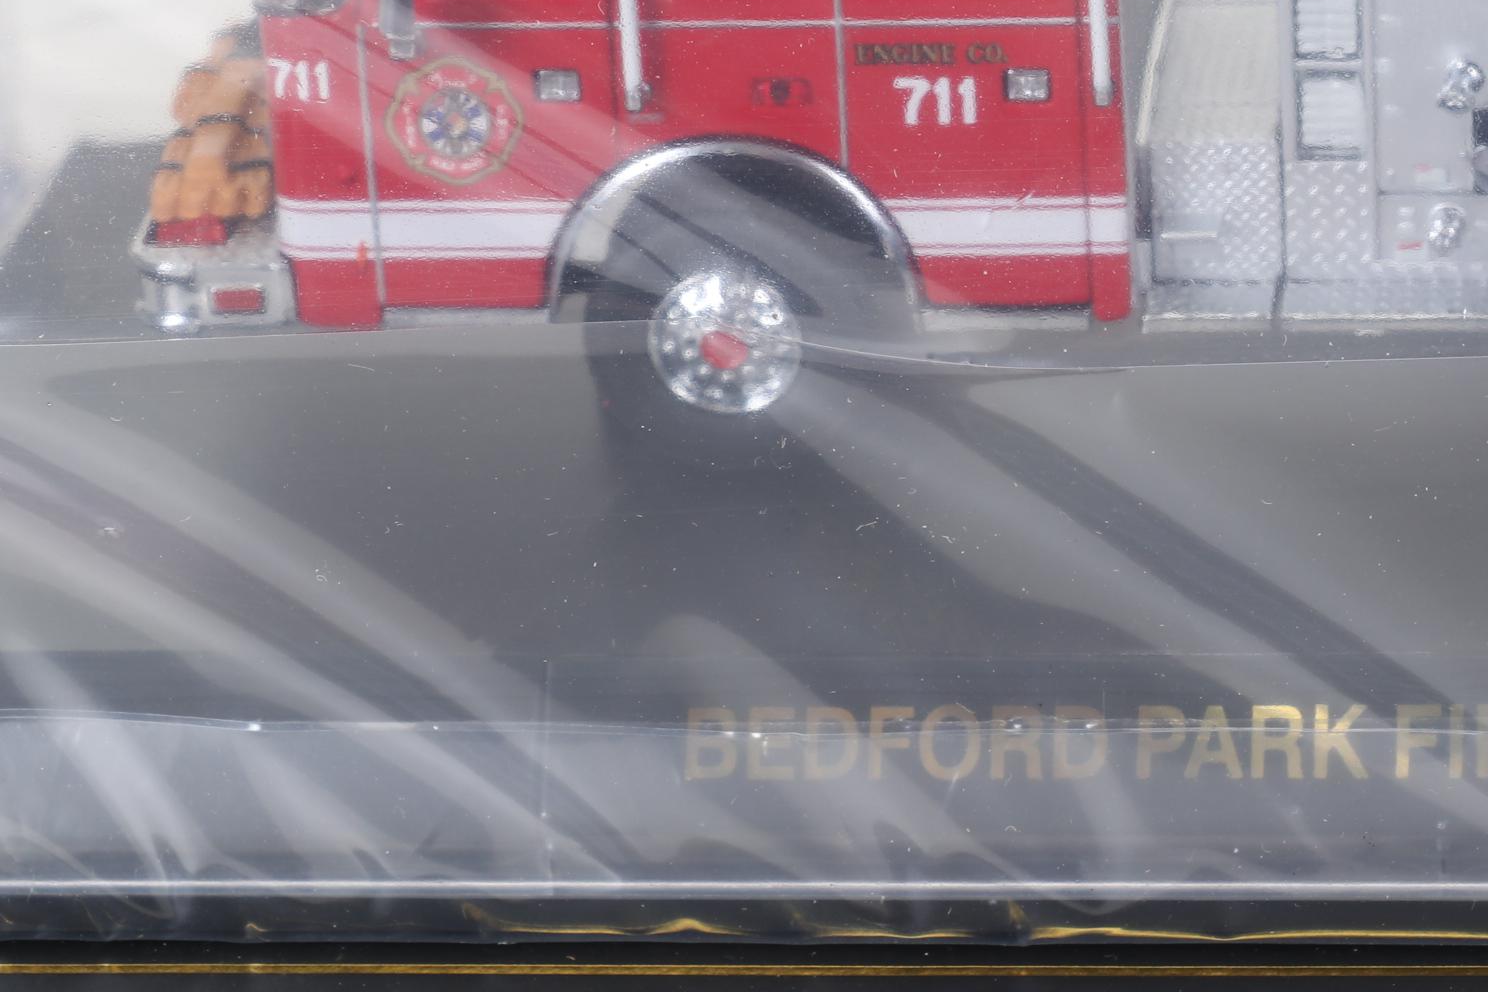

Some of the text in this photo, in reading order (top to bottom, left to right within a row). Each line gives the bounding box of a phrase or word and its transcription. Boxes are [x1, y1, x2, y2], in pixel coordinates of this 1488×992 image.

[855, 43, 956, 65] ENGINE
[267, 59, 331, 103] 711
[893, 75, 977, 126] 711
[684, 705, 1109, 781] BEDFORD
[1136, 704, 1369, 780] PARK
